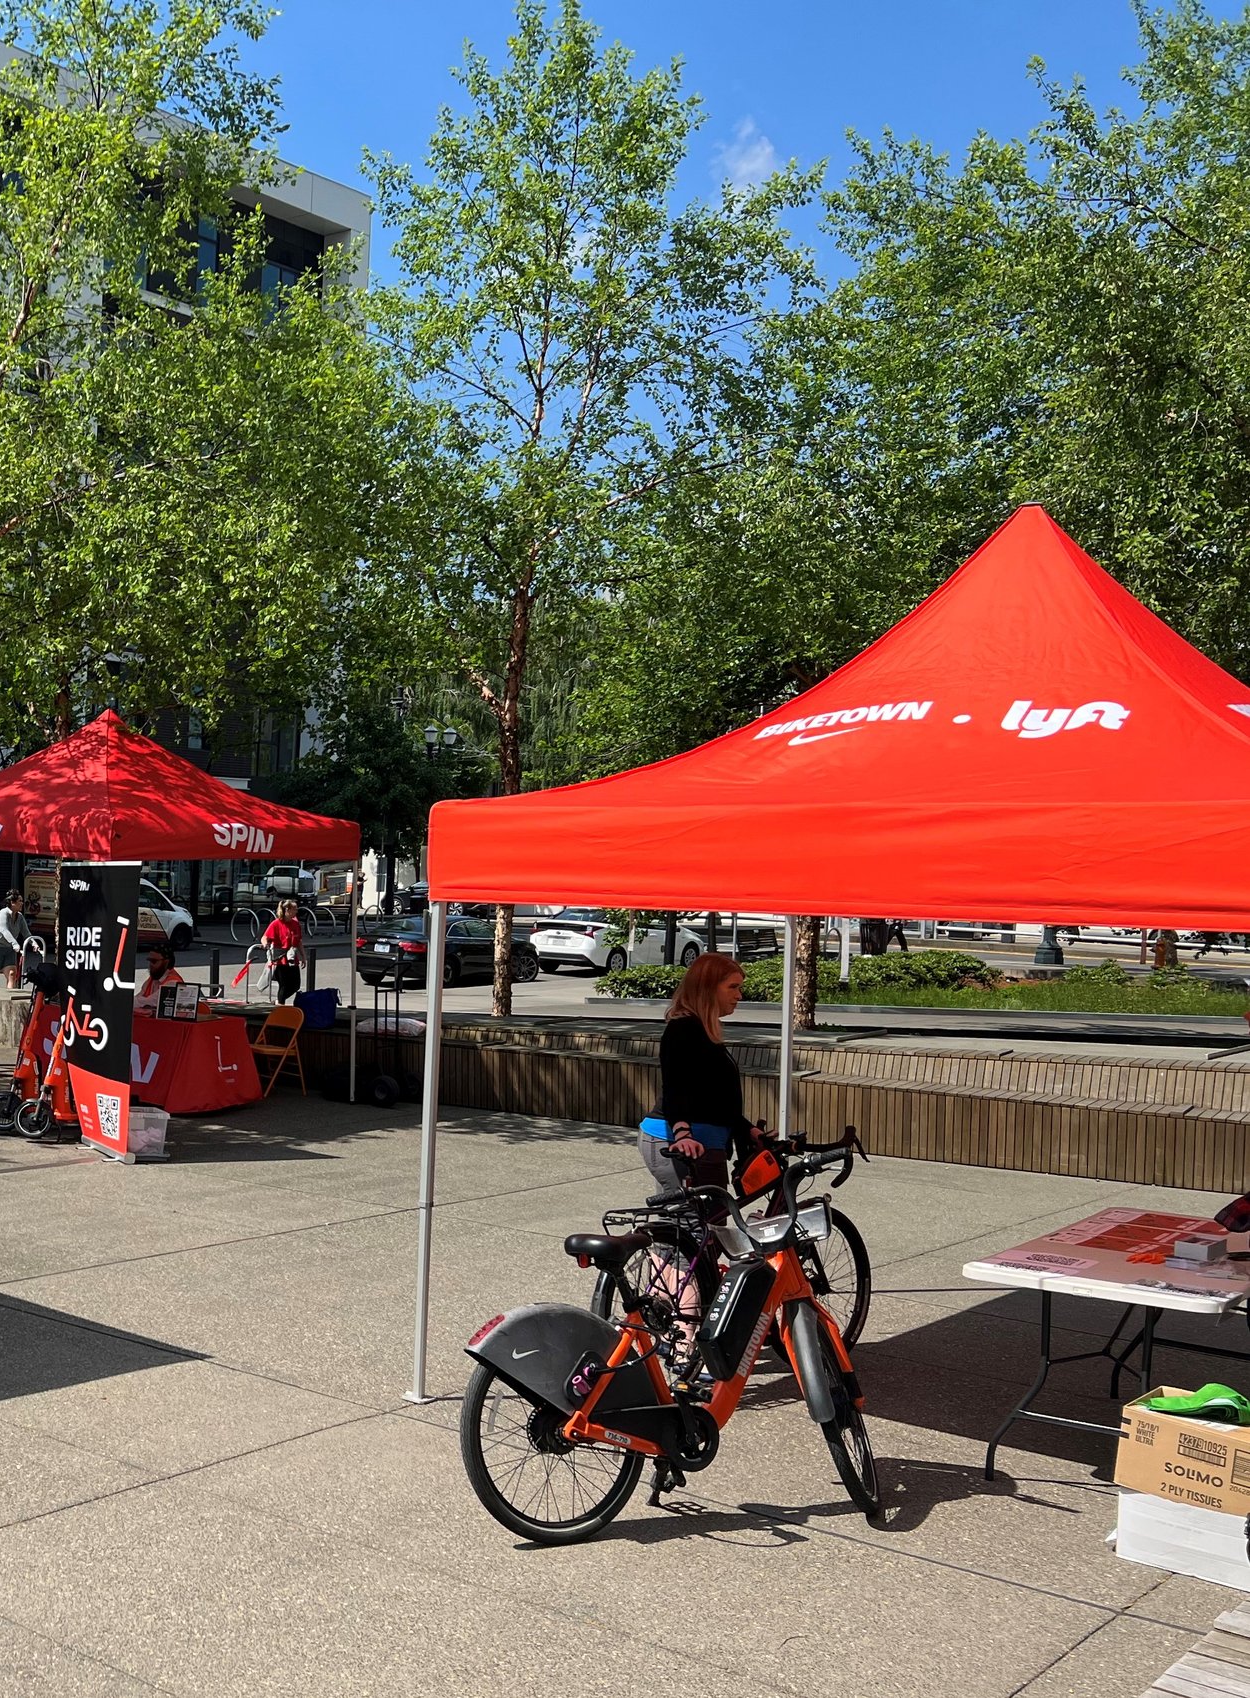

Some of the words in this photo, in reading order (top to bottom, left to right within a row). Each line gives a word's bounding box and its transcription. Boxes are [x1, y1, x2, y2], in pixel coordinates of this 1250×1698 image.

[752, 701, 934, 740] BIKETOWN
[1001, 700, 1131, 738] lyft
[212, 822, 274, 853] SPIN
[69, 879, 90, 892] SPIN
[66, 926, 102, 947] RIDE
[65, 949, 101, 971] SPIN
[736, 1312, 771, 1379] BIKETOWN
[1135, 1435, 1154, 1446] ULTRA
[1136, 1428, 1155, 1439] WHITE
[1164, 1462, 1224, 1488] SOLIMO
[1160, 1482, 1167, 1492] 2
[1168, 1484, 1185, 1497] PLY
[1186, 1489, 1223, 1509] TISSUES
